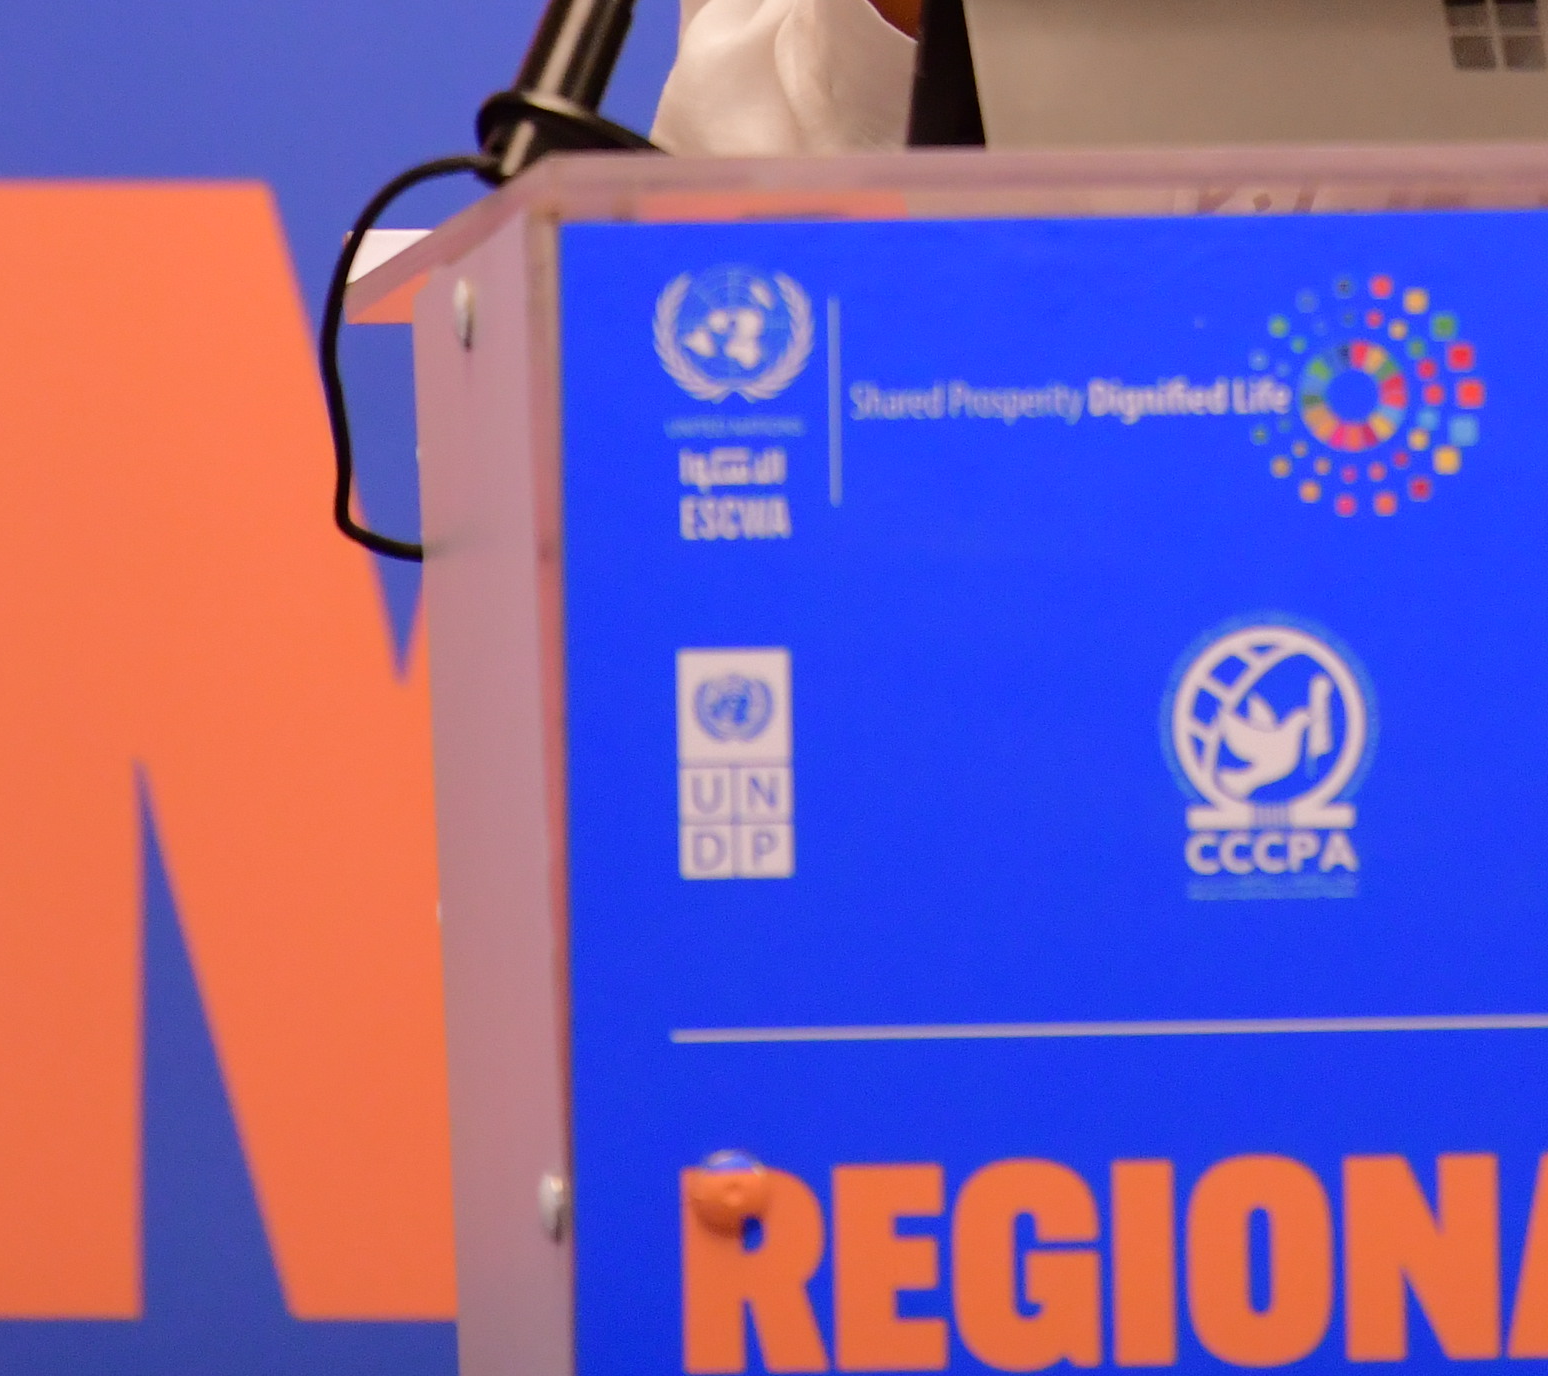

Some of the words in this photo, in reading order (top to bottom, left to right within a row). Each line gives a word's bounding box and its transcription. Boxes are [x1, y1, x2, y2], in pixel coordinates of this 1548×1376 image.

[849, 380, 946, 420] Shared
[950, 378, 1083, 425] Prosperity
[1088, 376, 1230, 425] Dignified
[1232, 375, 1292, 414] Life
[680, 495, 793, 541] ESCWA
[1184, 830, 1360, 875] CCCPA
